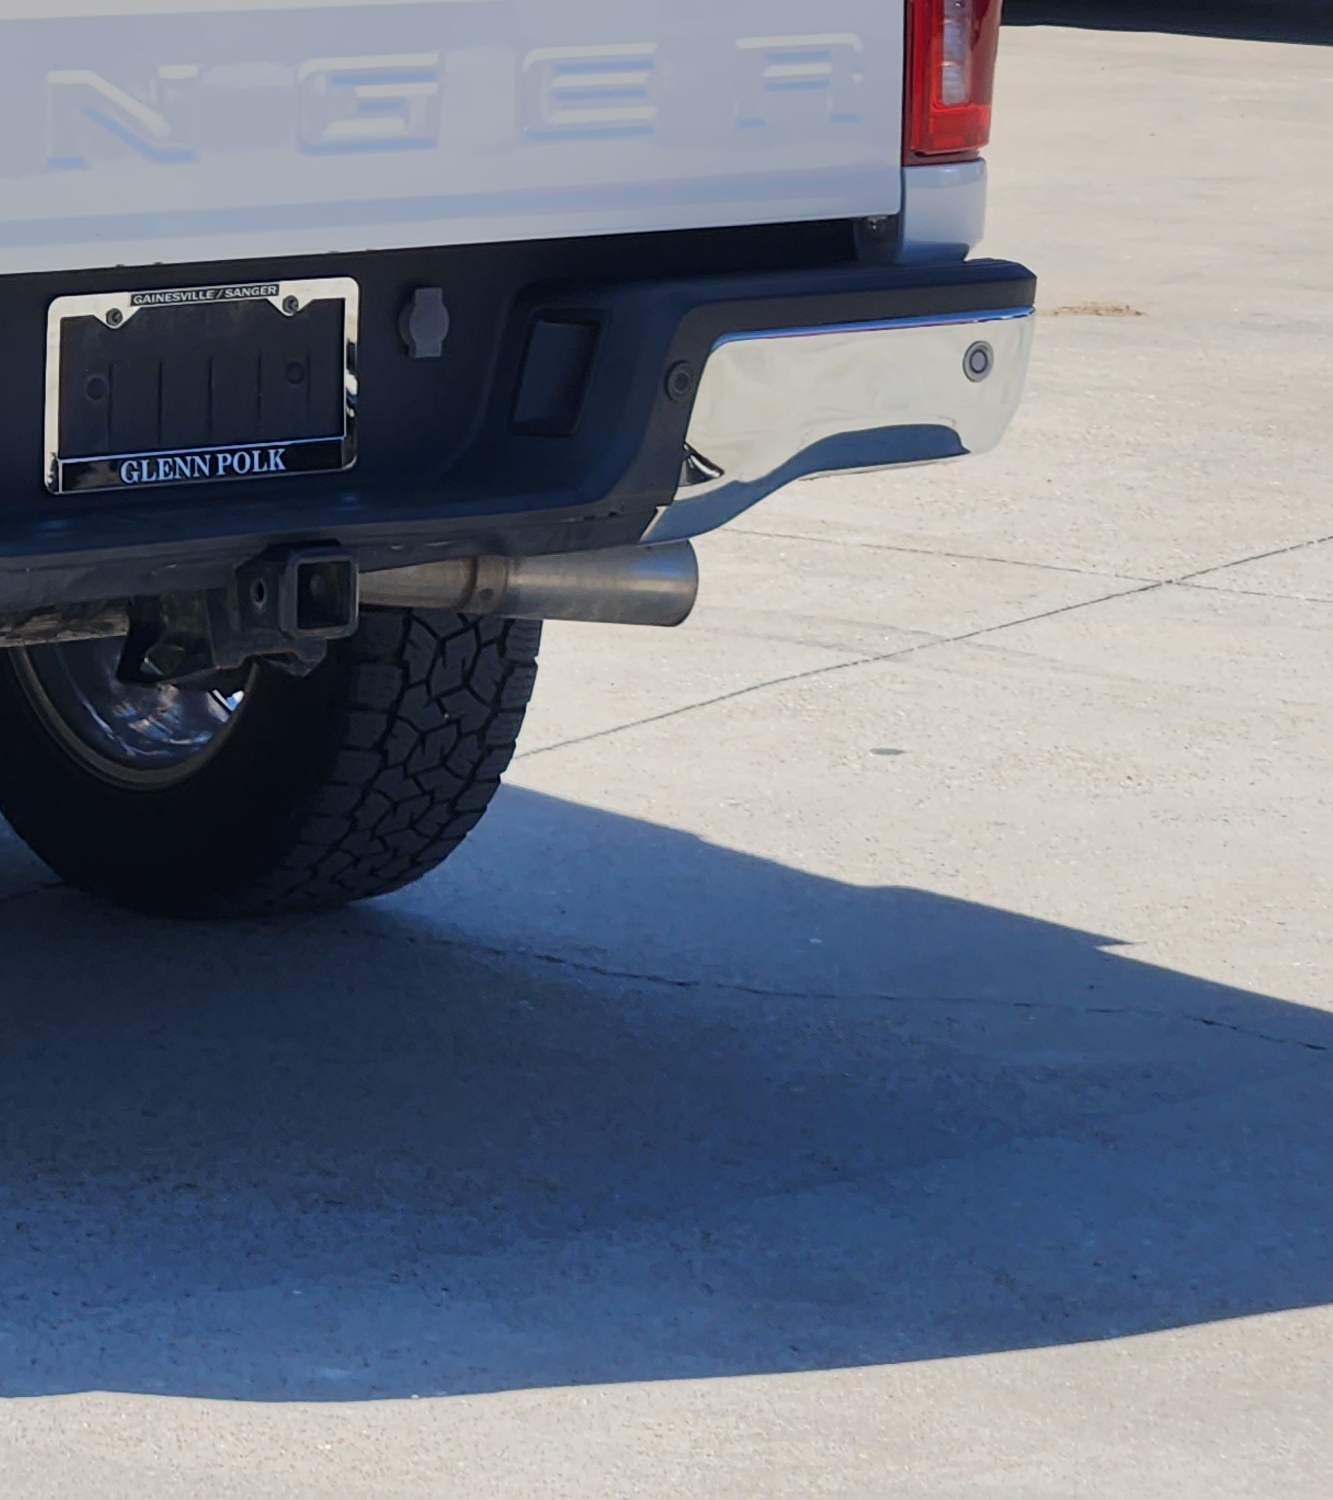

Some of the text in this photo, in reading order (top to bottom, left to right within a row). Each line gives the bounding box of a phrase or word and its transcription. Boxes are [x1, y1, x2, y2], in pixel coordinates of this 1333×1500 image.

[133, 289, 215, 305] GAINESVILLE
[224, 285, 278, 298] SANGER
[119, 448, 287, 484] GLENN POLK
